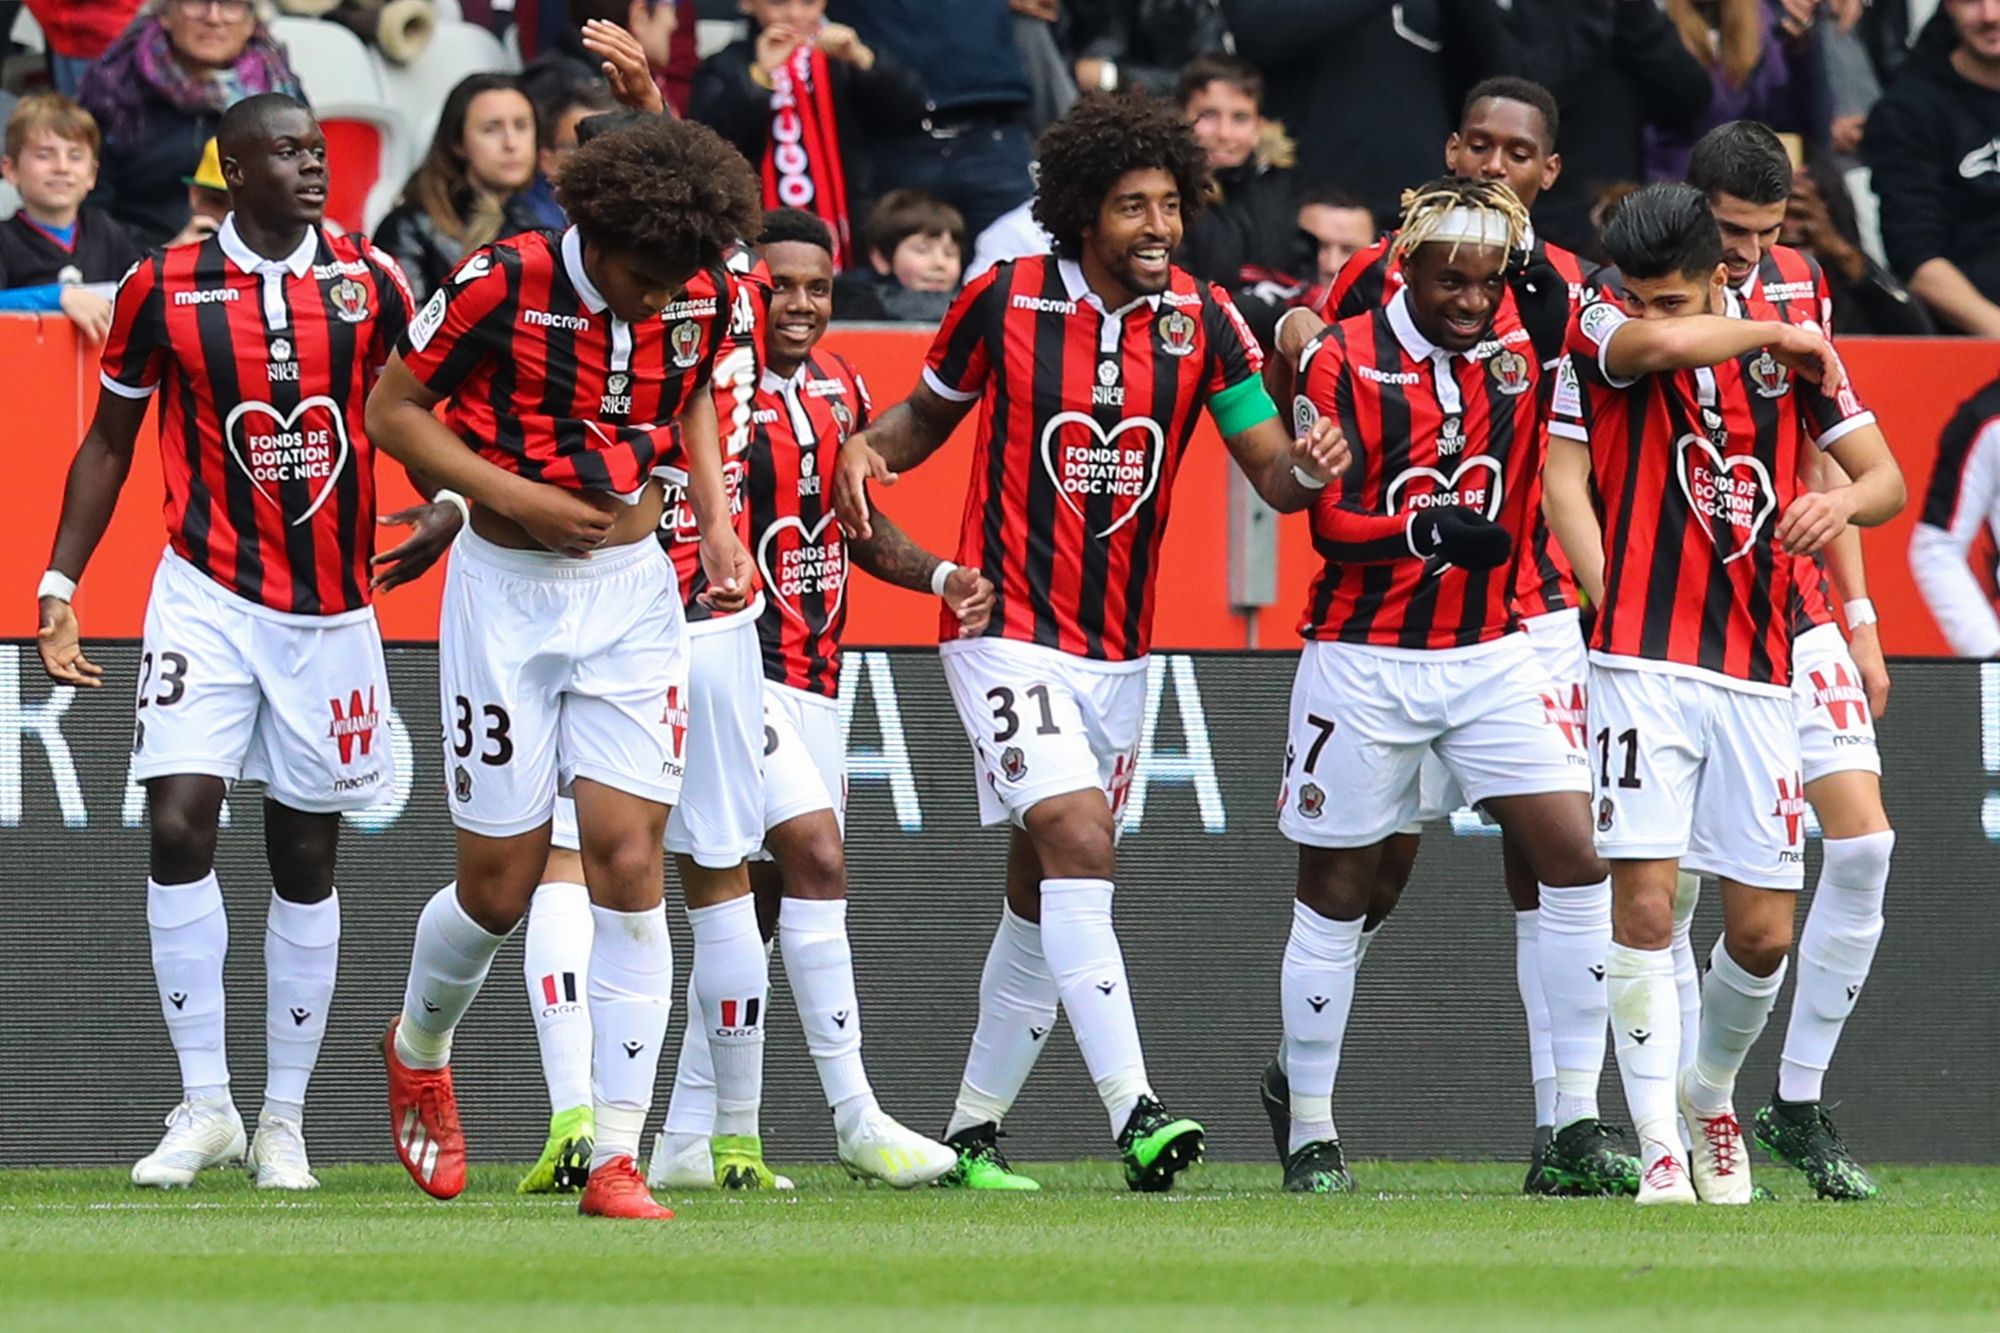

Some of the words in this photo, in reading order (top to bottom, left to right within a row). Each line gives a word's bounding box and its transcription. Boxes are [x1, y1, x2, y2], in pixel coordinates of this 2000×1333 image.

[175, 287, 240, 305] macron
[1012, 294, 1077, 315] macron
[524, 309, 589, 332] macron
[268, 369, 299, 381] NICE
[1358, 365, 1420, 385] macron
[599, 402, 631, 414] NICE
[1092, 392, 1125, 406] NICE
[752, 408, 779, 425] ron
[249, 432, 303, 451] FONDS
[308, 430, 328, 446] DE
[252, 445, 329, 466] DOTATION
[1066, 445, 1121, 464] FONDS
[1124, 449, 1145, 465] DE
[254, 466, 289, 481] OGC
[294, 461, 330, 480] NICE
[1064, 461, 1144, 481] DOTATION
[1063, 477, 1102, 494] OGC
[1106, 480, 1143, 496] NICE
[1736, 481, 1757, 497] DE
[1408, 491, 1460, 510] FONDS
[1464, 489, 1486, 505] DE
[1726, 510, 1753, 529] NICE
[782, 545, 826, 566] FONDS
[781, 558, 842, 581] DOTATION
[781, 579, 813, 597] OGC
[986, 684, 1061, 743] 31
[453, 695, 515, 767] 33
[1307, 713, 1336, 775] 7
[1596, 726, 1642, 789] 11
[334, 770, 380, 793] macron
[542, 1004, 584, 1018] OGC
[715, 1026, 760, 1037] OGC
